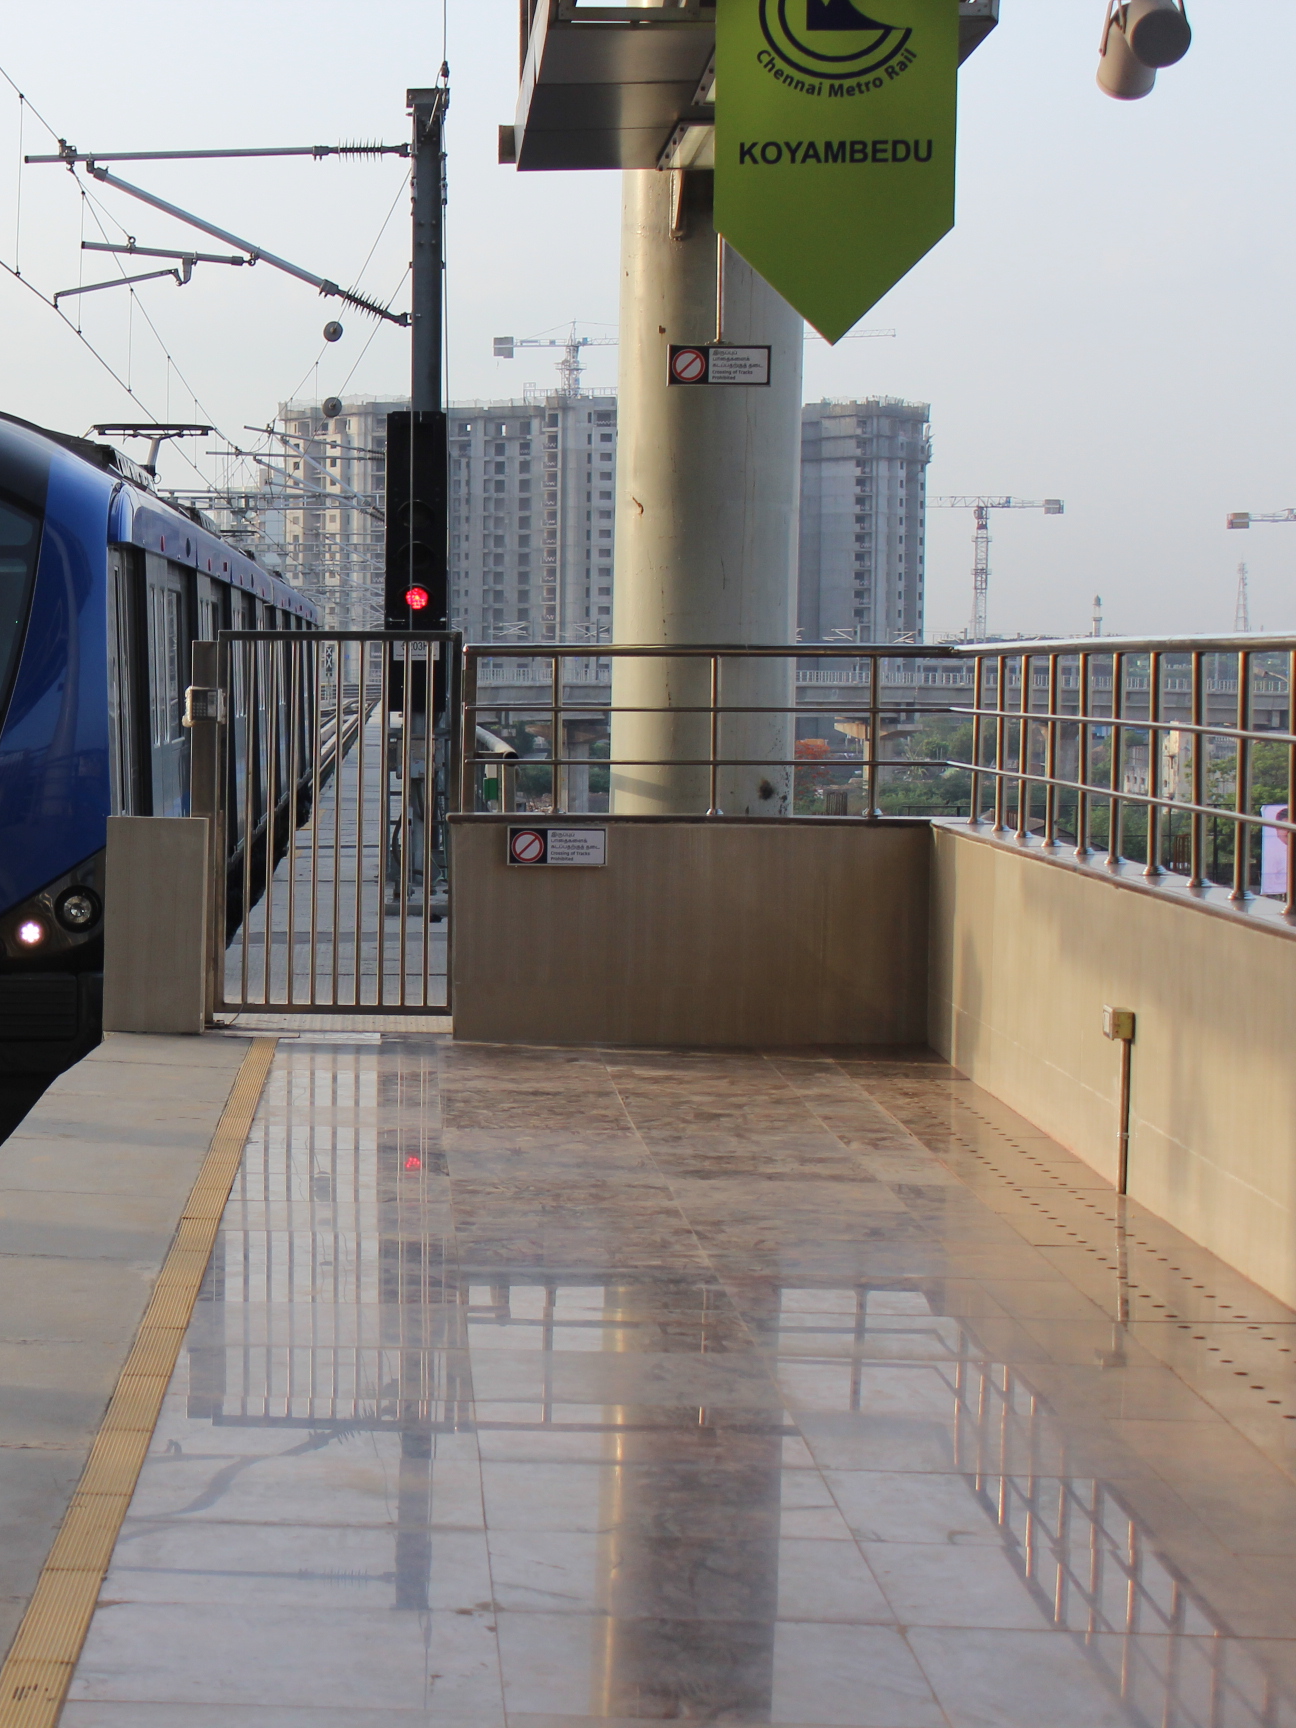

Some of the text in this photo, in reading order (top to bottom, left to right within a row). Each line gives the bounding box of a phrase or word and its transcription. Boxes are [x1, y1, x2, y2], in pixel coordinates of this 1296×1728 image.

[756, 47, 917, 98] Chennai Metro Rail
[739, 139, 933, 165] KOYAMBEDU
